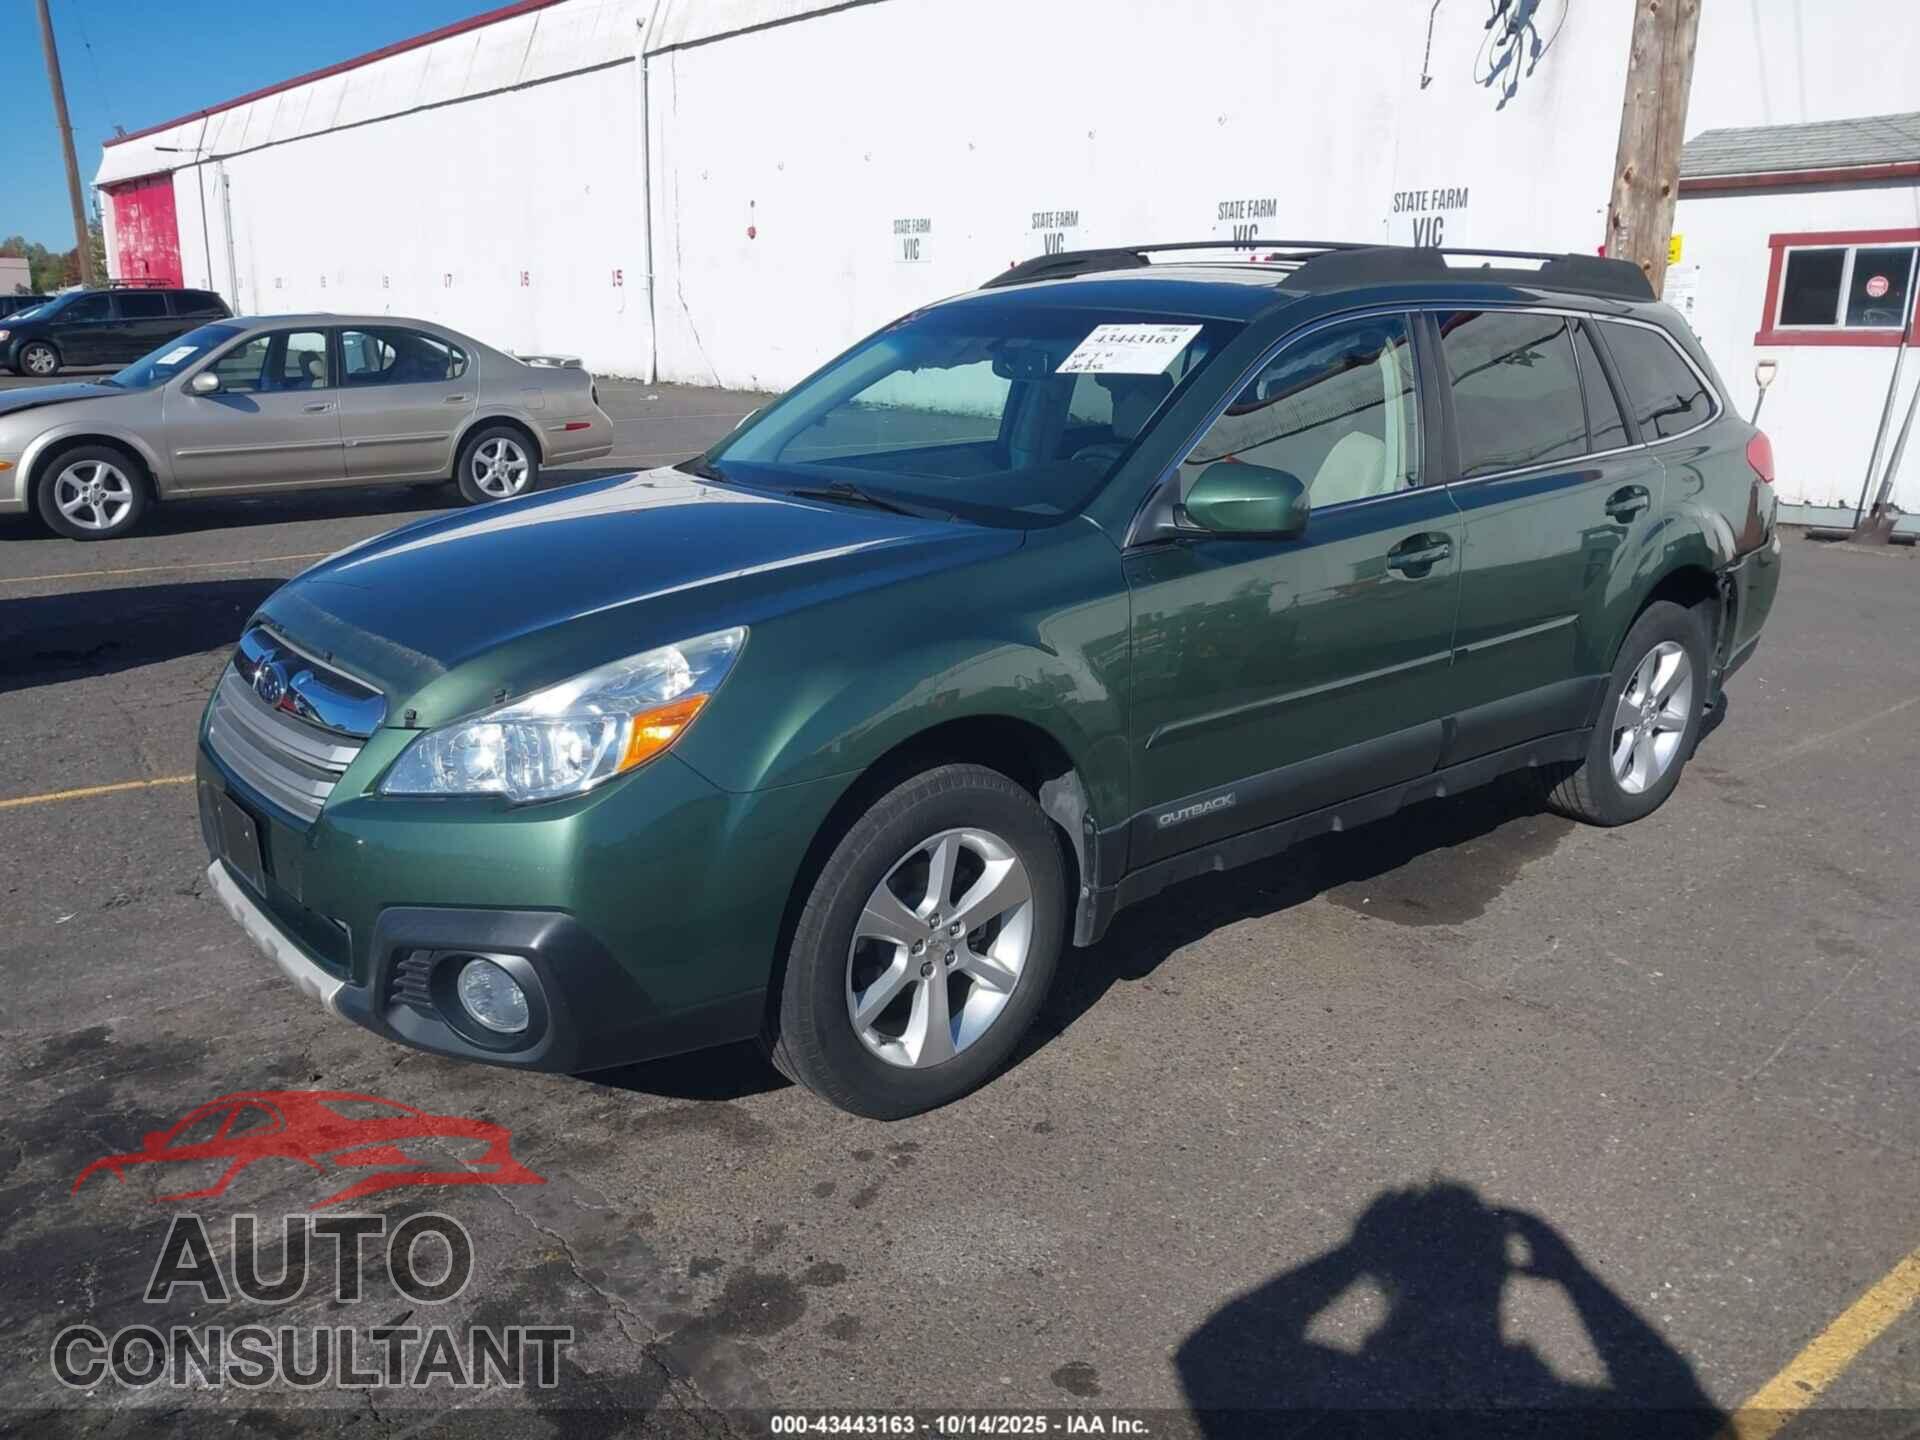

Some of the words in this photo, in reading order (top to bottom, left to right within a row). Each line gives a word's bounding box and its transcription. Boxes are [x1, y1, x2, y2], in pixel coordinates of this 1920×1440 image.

[1218, 201, 1245, 220] STATE
[1247, 198, 1277, 218] FARM
[1393, 191, 1428, 213] STATE
[1431, 187, 1469, 210] FARM
[894, 219, 911, 234] STATE
[912, 218, 931, 233] FARM
[1031, 212, 1053, 229] STATE
[1055, 210, 1078, 227] FARM
[1043, 232, 1065, 254] VIC
[1233, 224, 1258, 252] VIC
[1412, 216, 1444, 249] VIC
[903, 238, 920, 260] VIC
[612, 269, 624, 287] 15
[1159, 793, 1234, 825] OUTBACK
